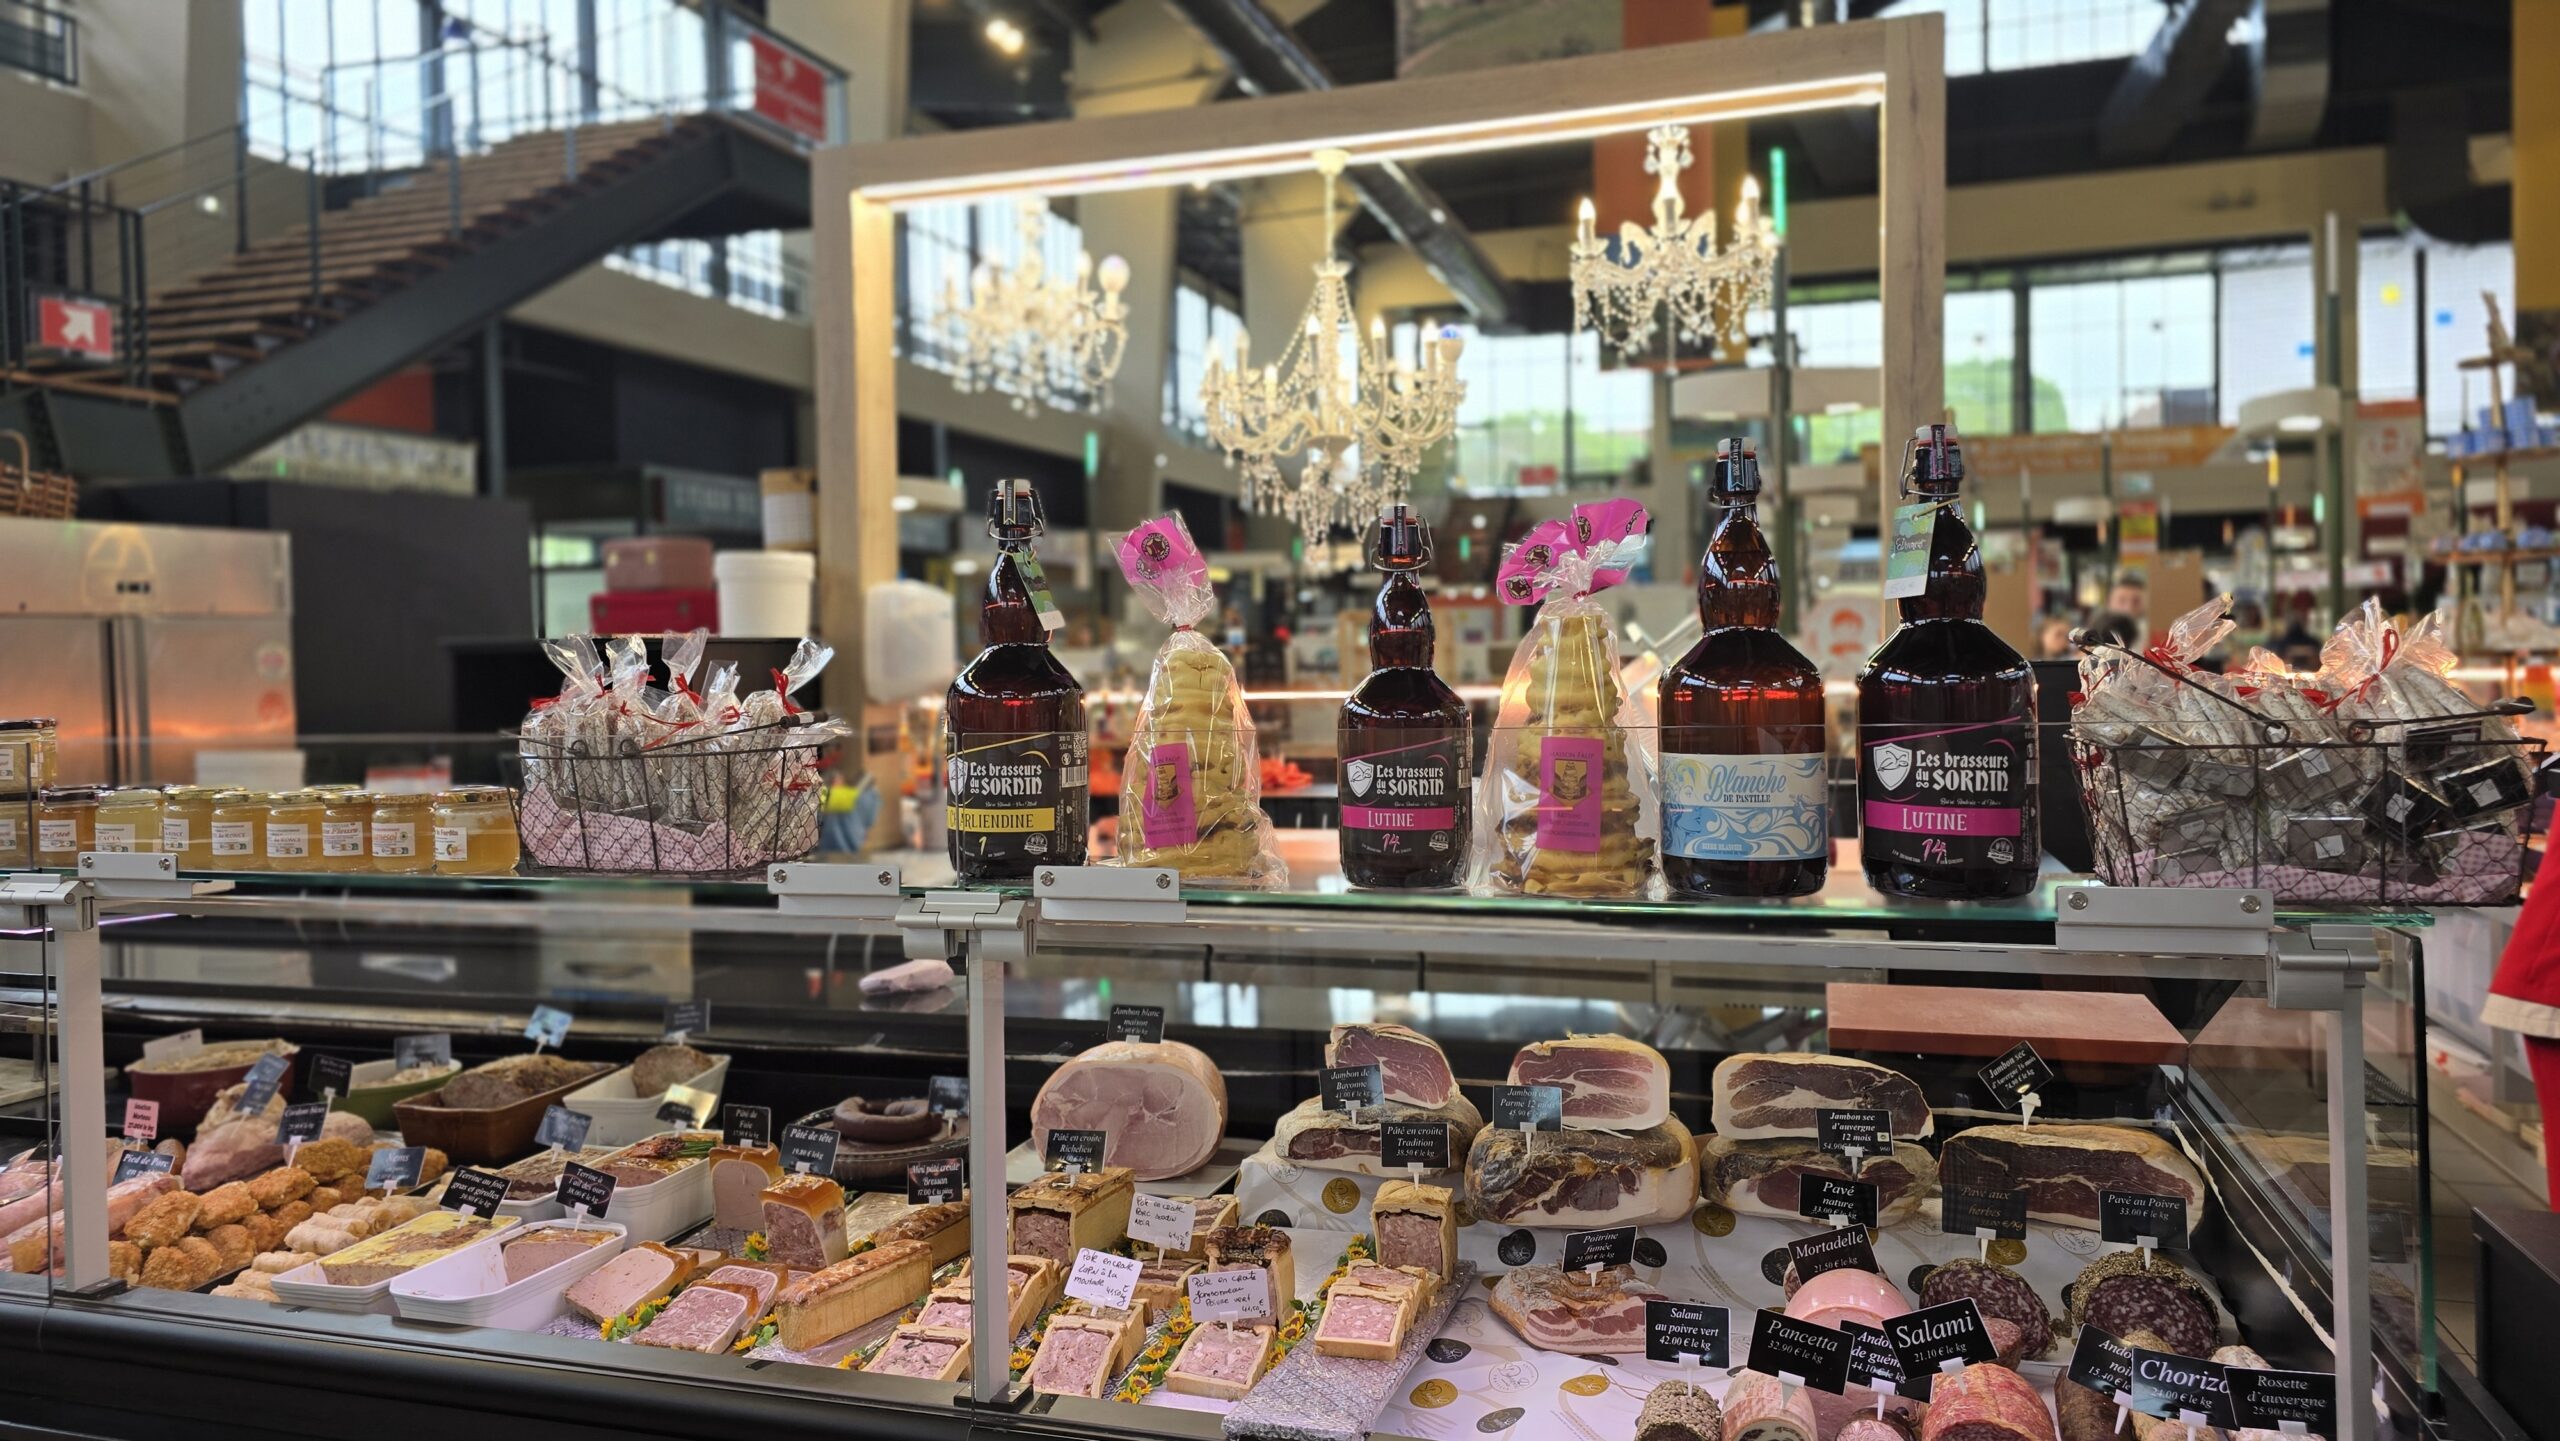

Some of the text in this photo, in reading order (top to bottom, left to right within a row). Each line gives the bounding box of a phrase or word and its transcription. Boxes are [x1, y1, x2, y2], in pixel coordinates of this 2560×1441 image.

[1916, 750, 2009, 768] Les brasseurs
[970, 762, 1042, 777] Les brasseurs
[1376, 764, 1444, 778] Les brasseurs
[981, 777, 1042, 796] SORNIN
[1703, 764, 1787, 802] Blanche
[1915, 768, 2009, 793] du SORNIN
[1388, 778, 1444, 797] SORNIN
[1723, 794, 1771, 803] DE PASTILLE
[1331, 1068, 1370, 1080] Jambon de
[1337, 1082, 1368, 1091] Bayonne
[1507, 1087, 1538, 1098] Jambon
[1500, 1098, 1537, 1108] Parme 12
[1829, 1112, 1861, 1121] Jambon
[1387, 1126, 1405, 1135] Pâté
[1417, 1127, 1444, 1136] croûte
[1832, 1123, 1876, 1132] d'auvergne
[808, 1131, 818, 1141] de
[1070, 1134, 1079, 1142] en
[1397, 1138, 1434, 1147] Tradition
[1842, 1133, 1872, 1142] 12 mois
[1060, 1144, 1093, 1153] Richelieu
[458, 1170, 481, 1183] Terrine
[576, 1169, 598, 1181] Terrine
[474, 1188, 500, 1200] girolles
[1822, 1182, 1855, 1197] Pavé
[1988, 1190, 2011, 1200] aux
[1822, 1197, 1854, 1209] nature
[2108, 1194, 2180, 1210] Pavé au Poivre
[1968, 1204, 2001, 1217] herbes
[2120, 1206, 2170, 1221] 33.00 kg
[1583, 1232, 1619, 1243] Poitrine
[1584, 1242, 1612, 1255] fumée
[1796, 1231, 1863, 1259] Mortadelle
[1814, 1262, 1834, 1273] 21.50
[1848, 1256, 1858, 1264] kg
[1670, 1307, 1703, 1320] Salami
[1655, 1323, 1719, 1337] au poivre vert
[1767, 1319, 1838, 1352] Pancetta
[1896, 1310, 1975, 1348] Salami
[1659, 1335, 1711, 1351] 42.00 € le kg
[1767, 1340, 1824, 1364] 32.90 € le kg
[1851, 1345, 1866, 1358] de
[1914, 1343, 1967, 1362] 21.10 € le kg
[1895, 1374, 1906, 1384] kg
[2140, 1359, 2229, 1394] Chorizo
[2258, 1375, 2308, 1390] Rosette
[2114, 1377, 2122, 1386] €
[2122, 1380, 2131, 1391] le
[2151, 1387, 2213, 1408] 24.00 € le kg
[2246, 1391, 2327, 1409] d'auvergne
[2253, 1406, 2319, 1421] 25.90 € le kg
